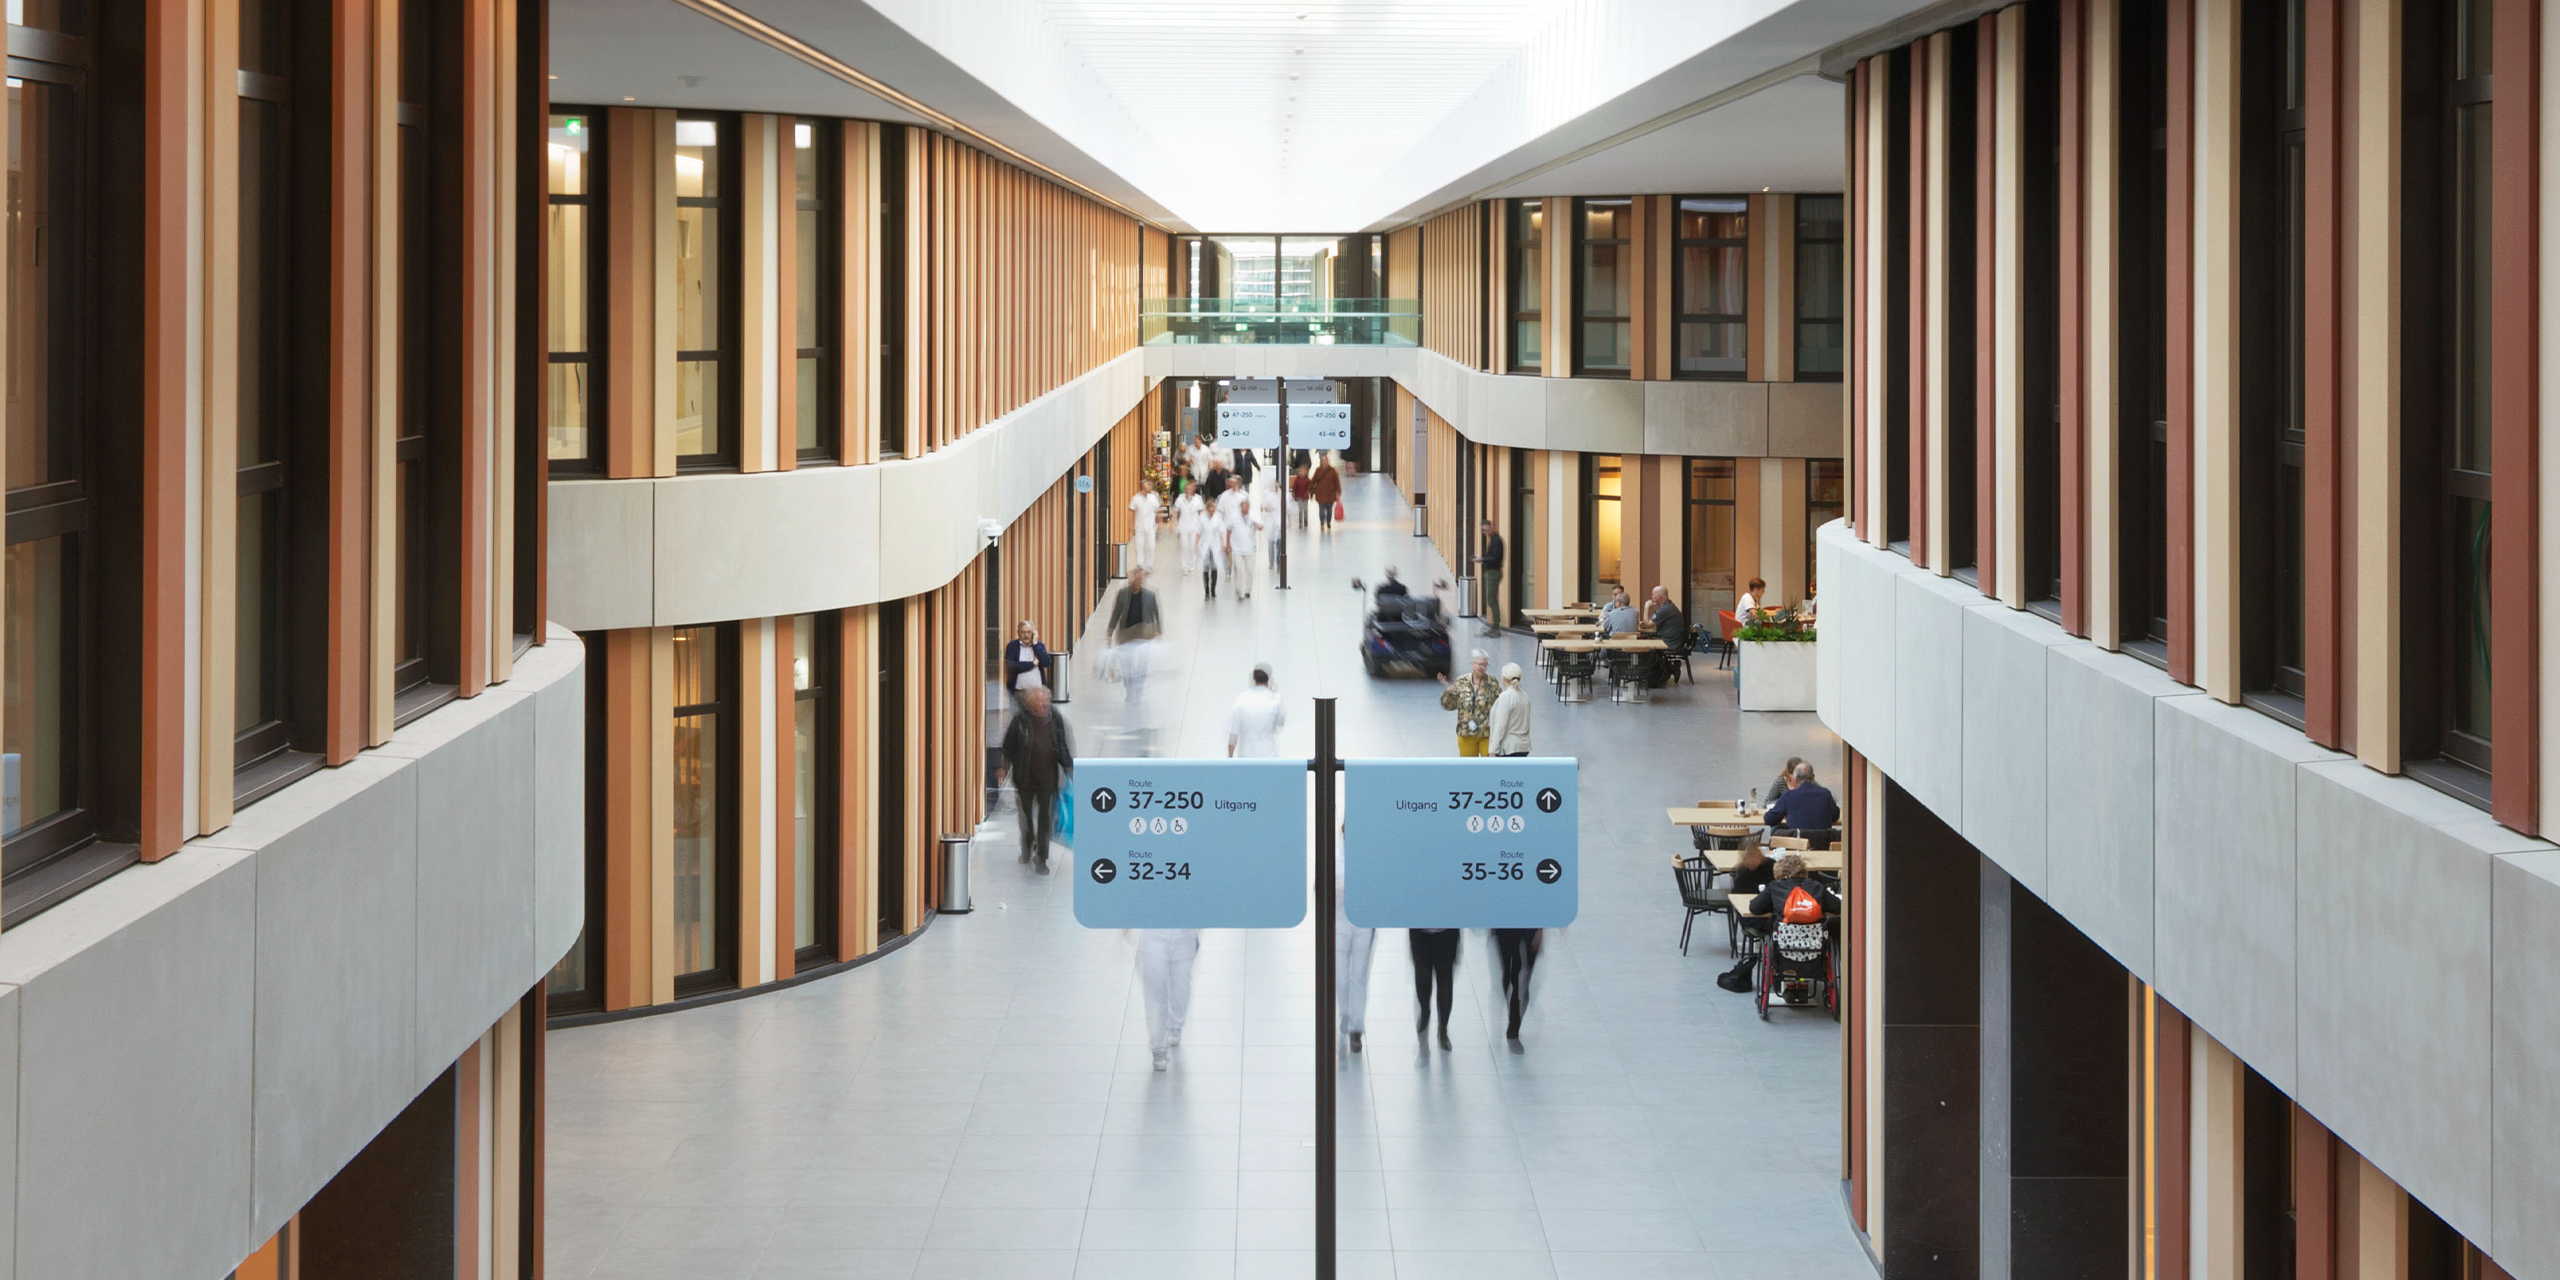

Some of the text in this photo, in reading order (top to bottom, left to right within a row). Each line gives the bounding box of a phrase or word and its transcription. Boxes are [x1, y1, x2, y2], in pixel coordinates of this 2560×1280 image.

[1128, 779, 1153, 788] Route
[1500, 779, 1524, 788] Route
[1128, 791, 1257, 812] 37-250 Uitgang
[1396, 791, 1524, 812] Uitgang 37-250
[1128, 850, 1153, 859] Route
[1500, 850, 1524, 859] Route
[1128, 862, 1191, 881] 32-34
[1461, 862, 1524, 881] 35-36
